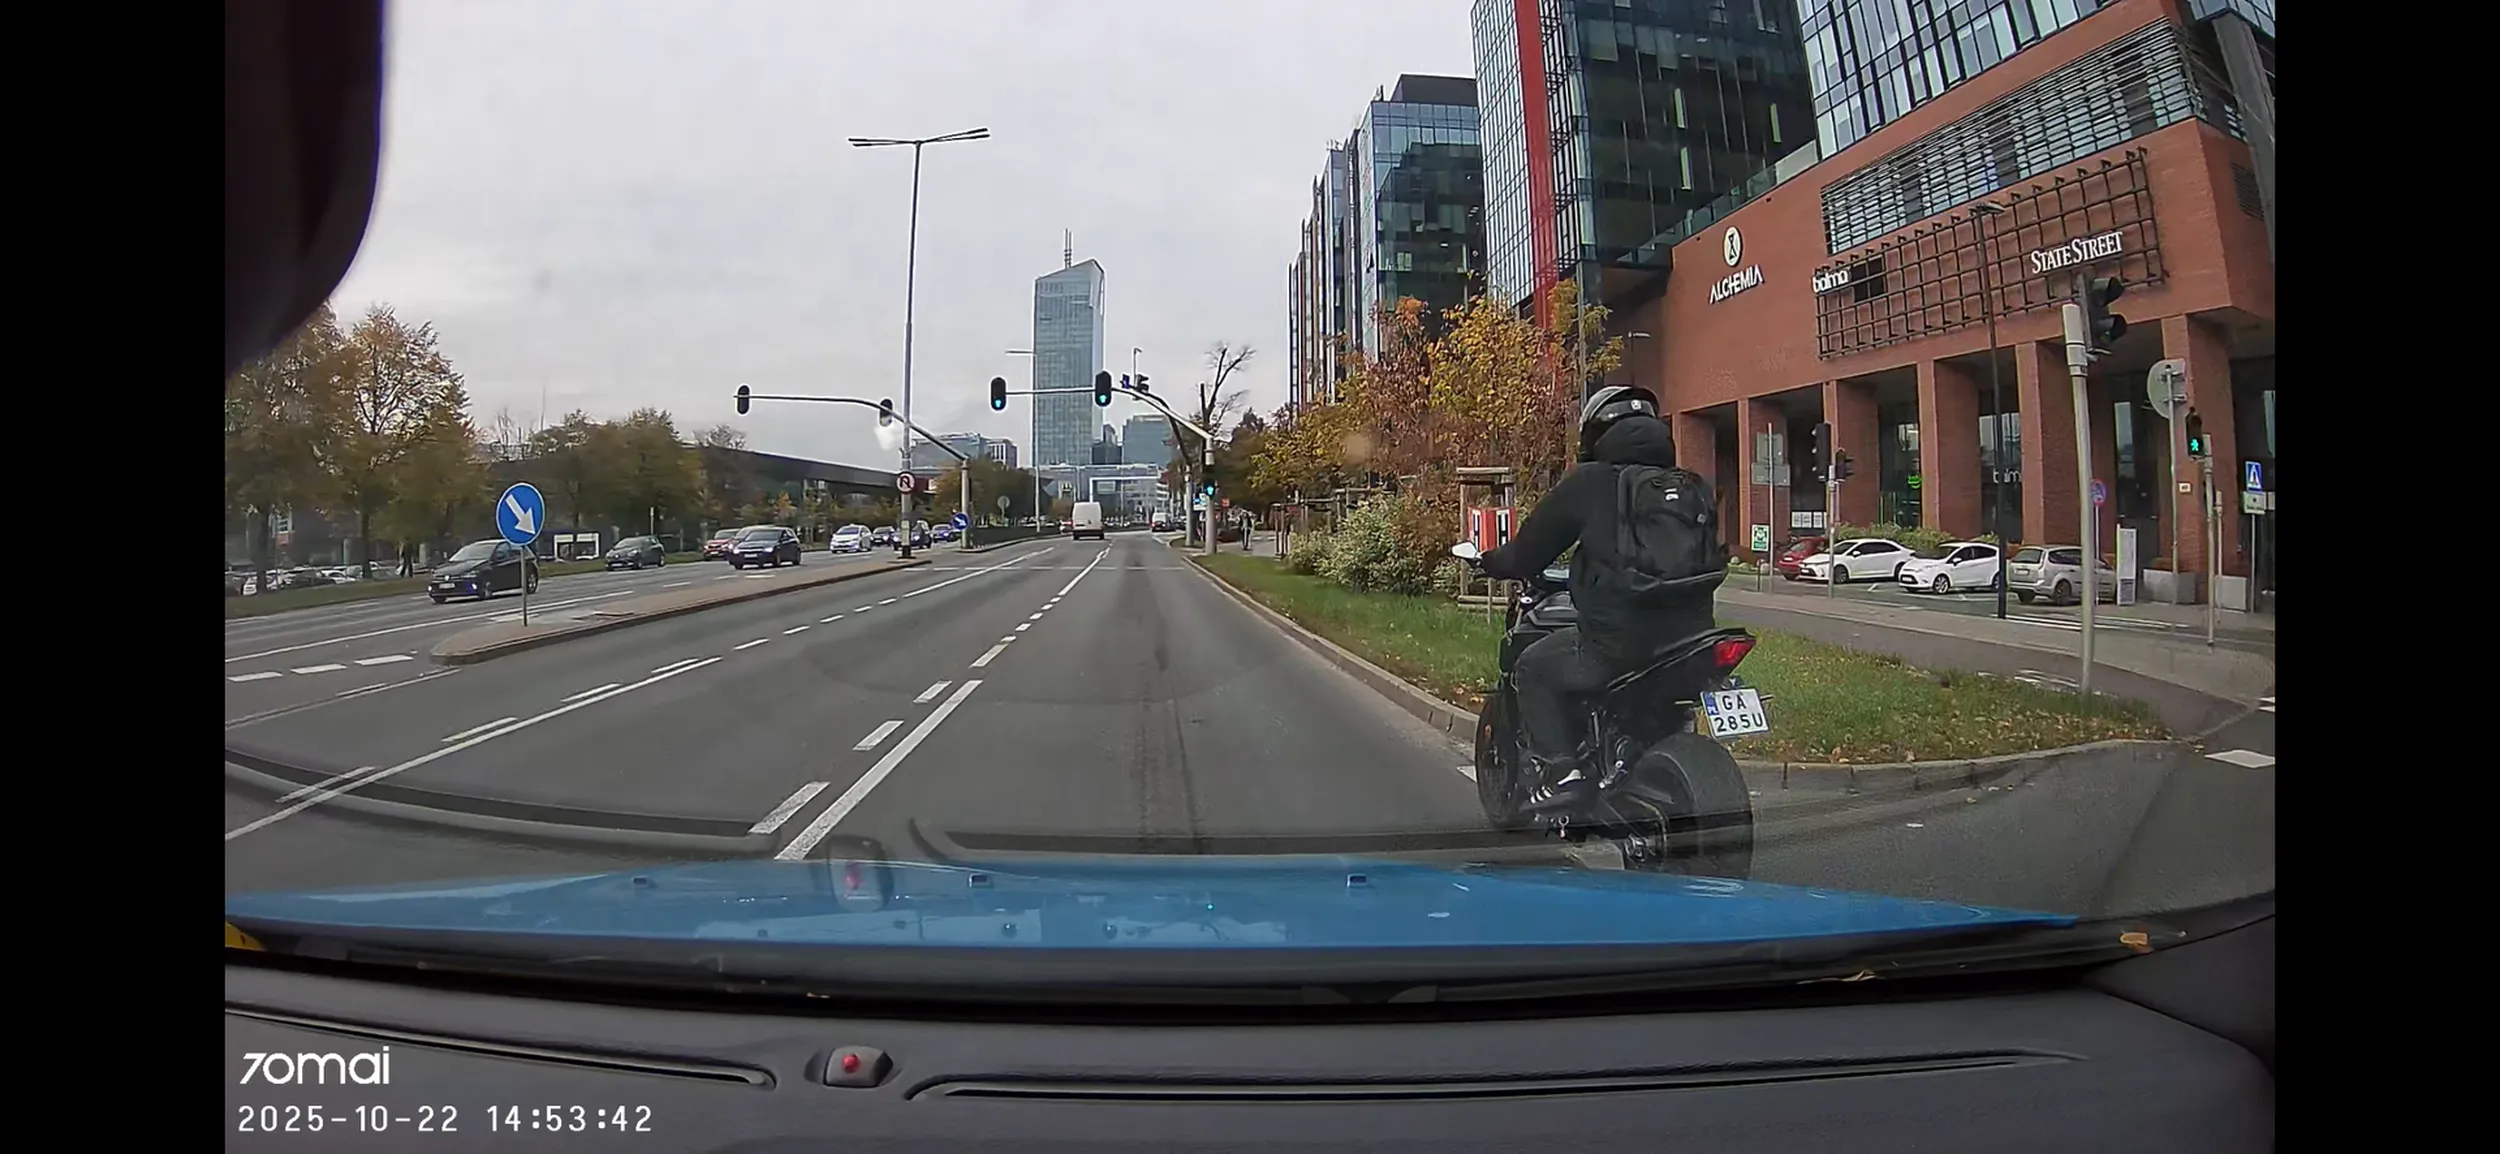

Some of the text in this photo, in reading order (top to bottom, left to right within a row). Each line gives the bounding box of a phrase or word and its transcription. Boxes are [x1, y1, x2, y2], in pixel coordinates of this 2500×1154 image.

[2072, 231, 2123, 263] STREET
[1709, 264, 1764, 304] ALCHEMIA
[1722, 692, 1747, 711] GA
[1714, 713, 1763, 732] 285U
